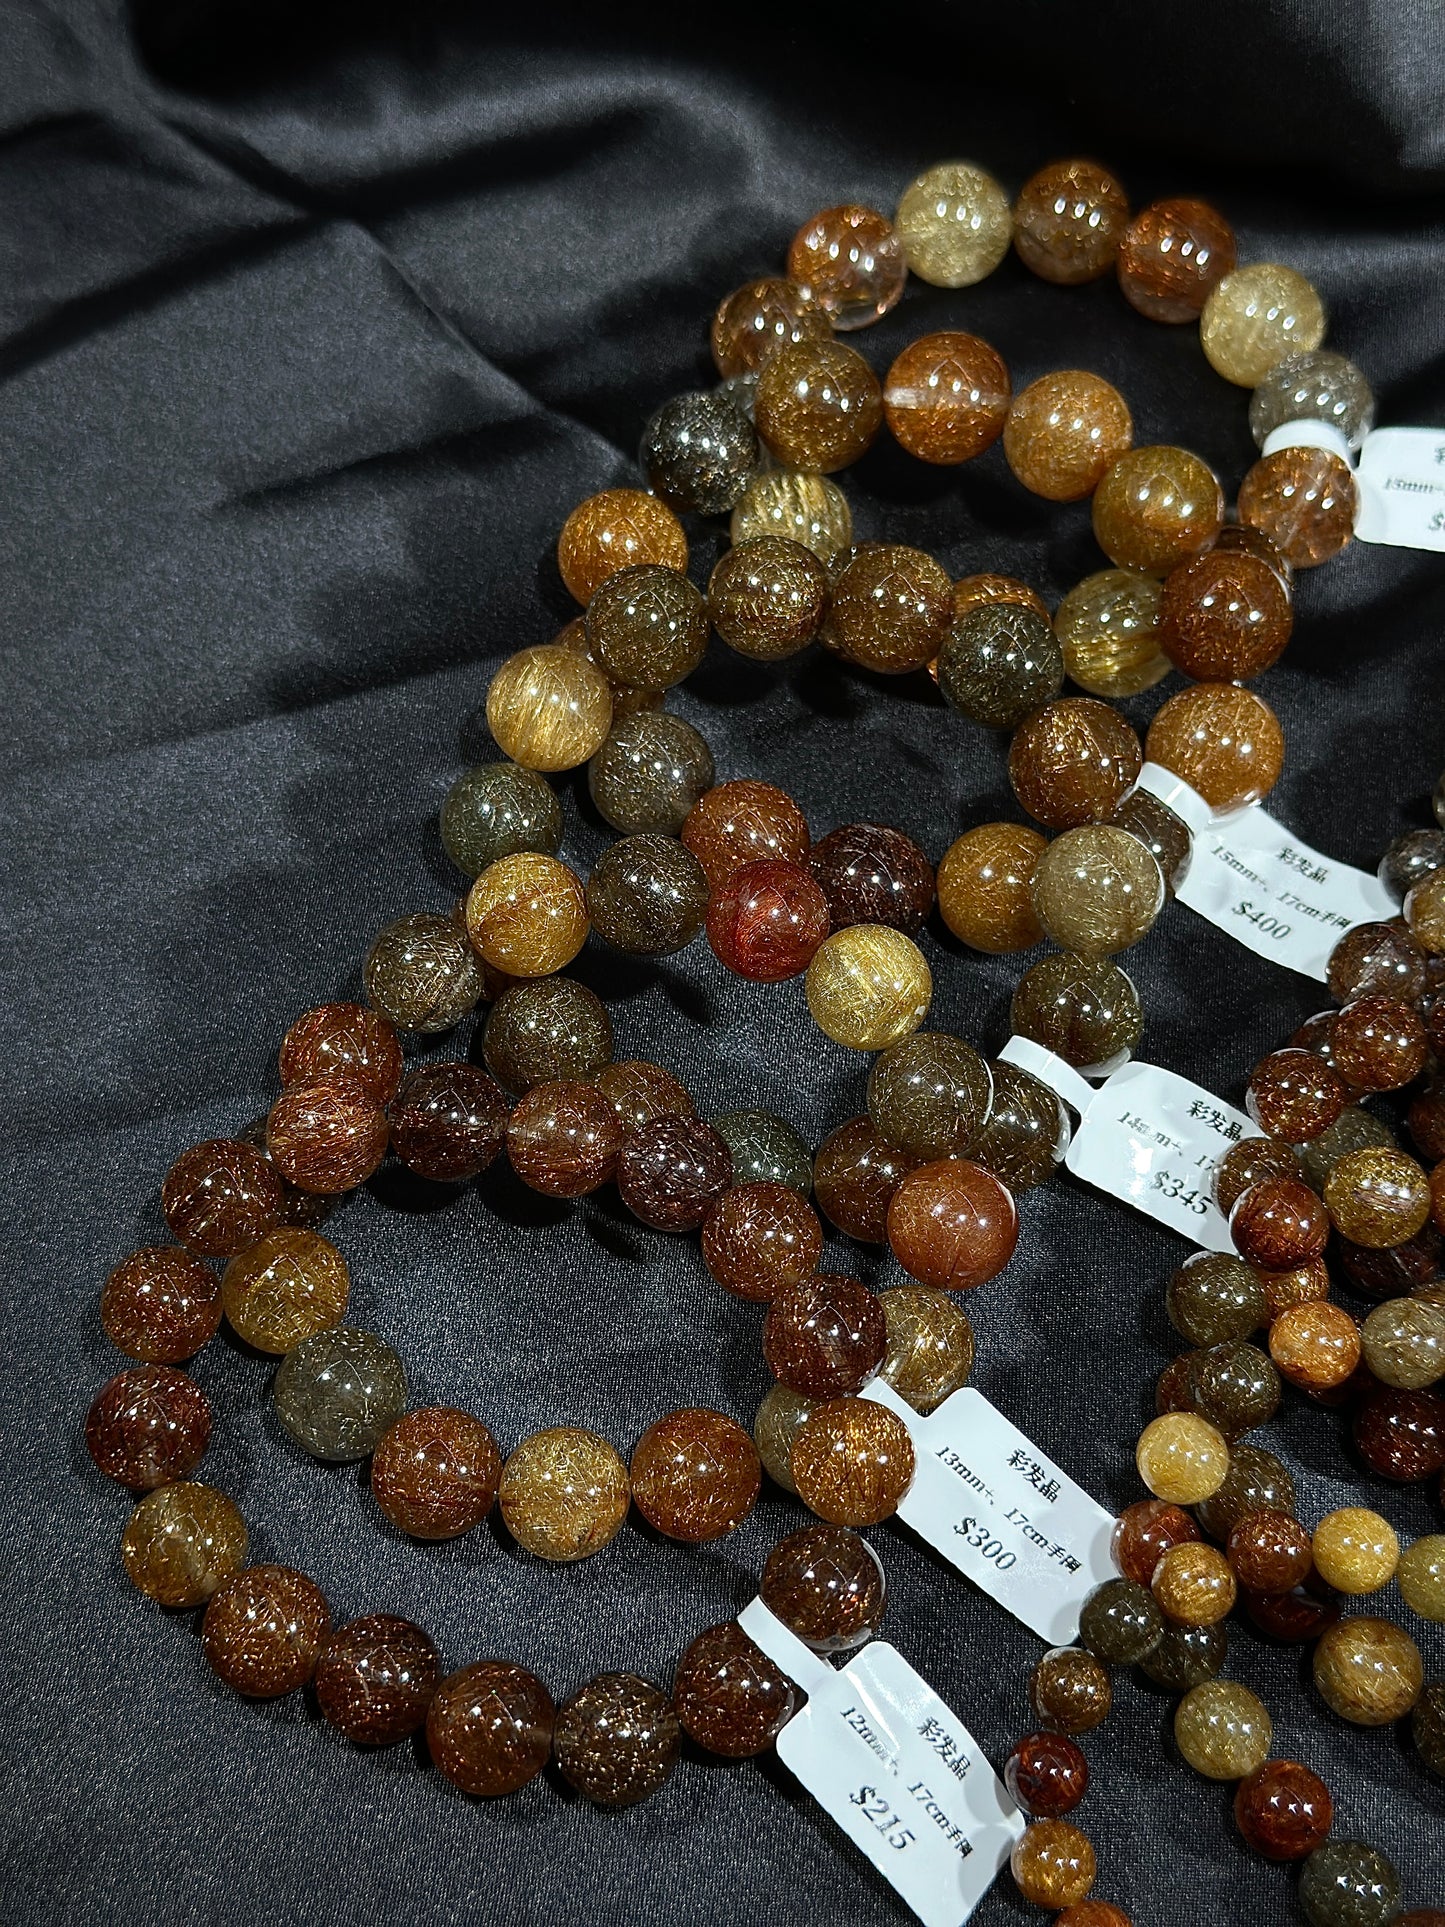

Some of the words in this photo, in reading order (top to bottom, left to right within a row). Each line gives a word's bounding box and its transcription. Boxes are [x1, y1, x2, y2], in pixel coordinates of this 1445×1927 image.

[1277, 847, 1330, 884] 彩发晶
[1232, 900, 1291, 940] $400
[1186, 1100, 1242, 1142] 彩发晶
[1149, 1170, 1212, 1214] $345
[1006, 1448, 1061, 1503] 彩发晶
[953, 1517, 1017, 1570] $300
[917, 1716, 971, 1781] 彩发晶
[849, 1785, 917, 1850] $215
